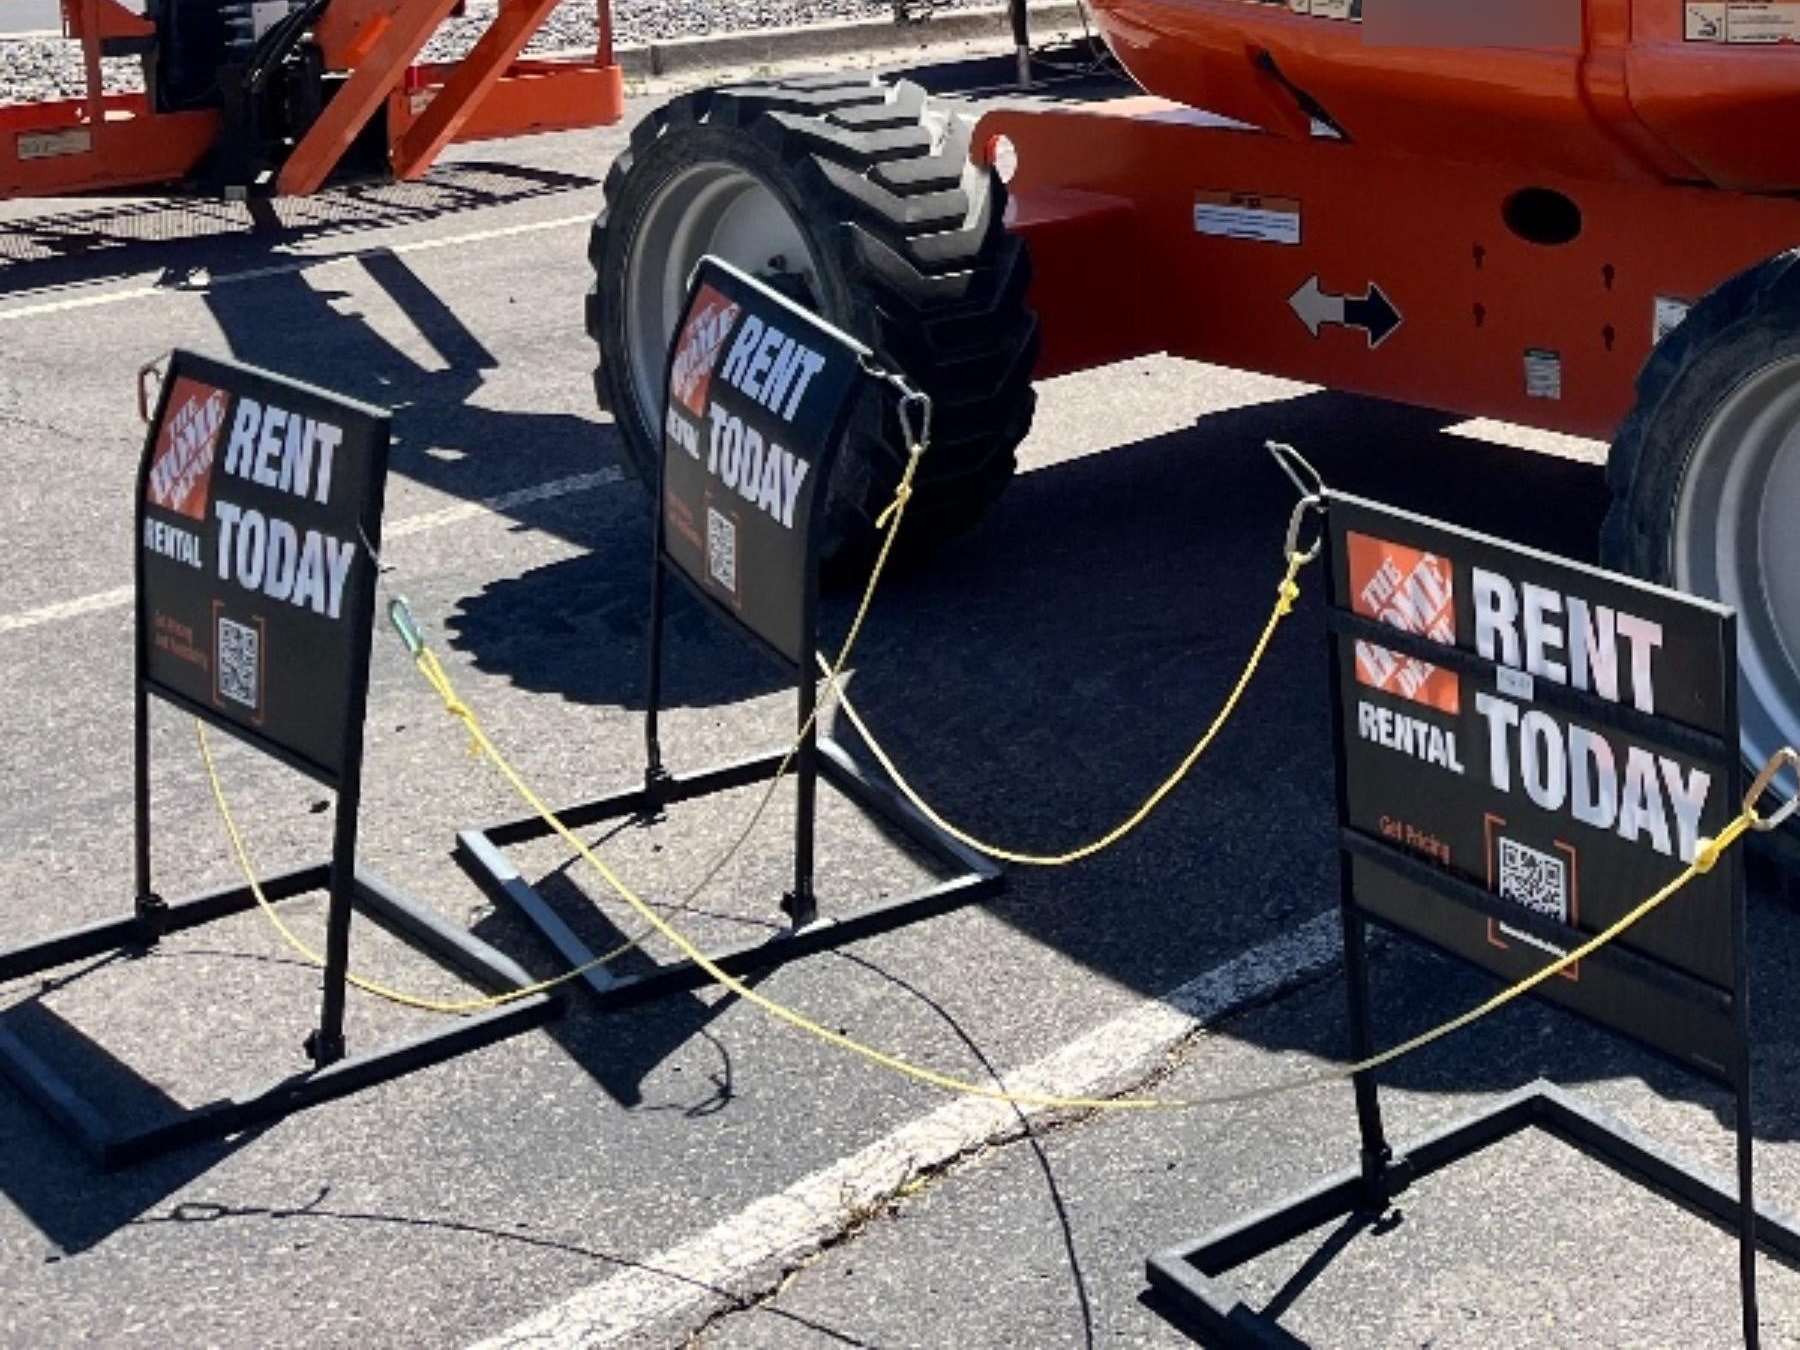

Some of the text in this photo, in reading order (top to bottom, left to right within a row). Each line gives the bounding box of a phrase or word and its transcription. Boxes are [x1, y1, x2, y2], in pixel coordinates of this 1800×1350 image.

[720, 314, 826, 422] RENT
[224, 398, 343, 505] RENT
[707, 402, 811, 529] TODAY
[215, 500, 356, 619] TODAY
[1472, 567, 1662, 715] RENT
[1358, 701, 1464, 774] RENTAL
[1475, 692, 1711, 864] TODAY
